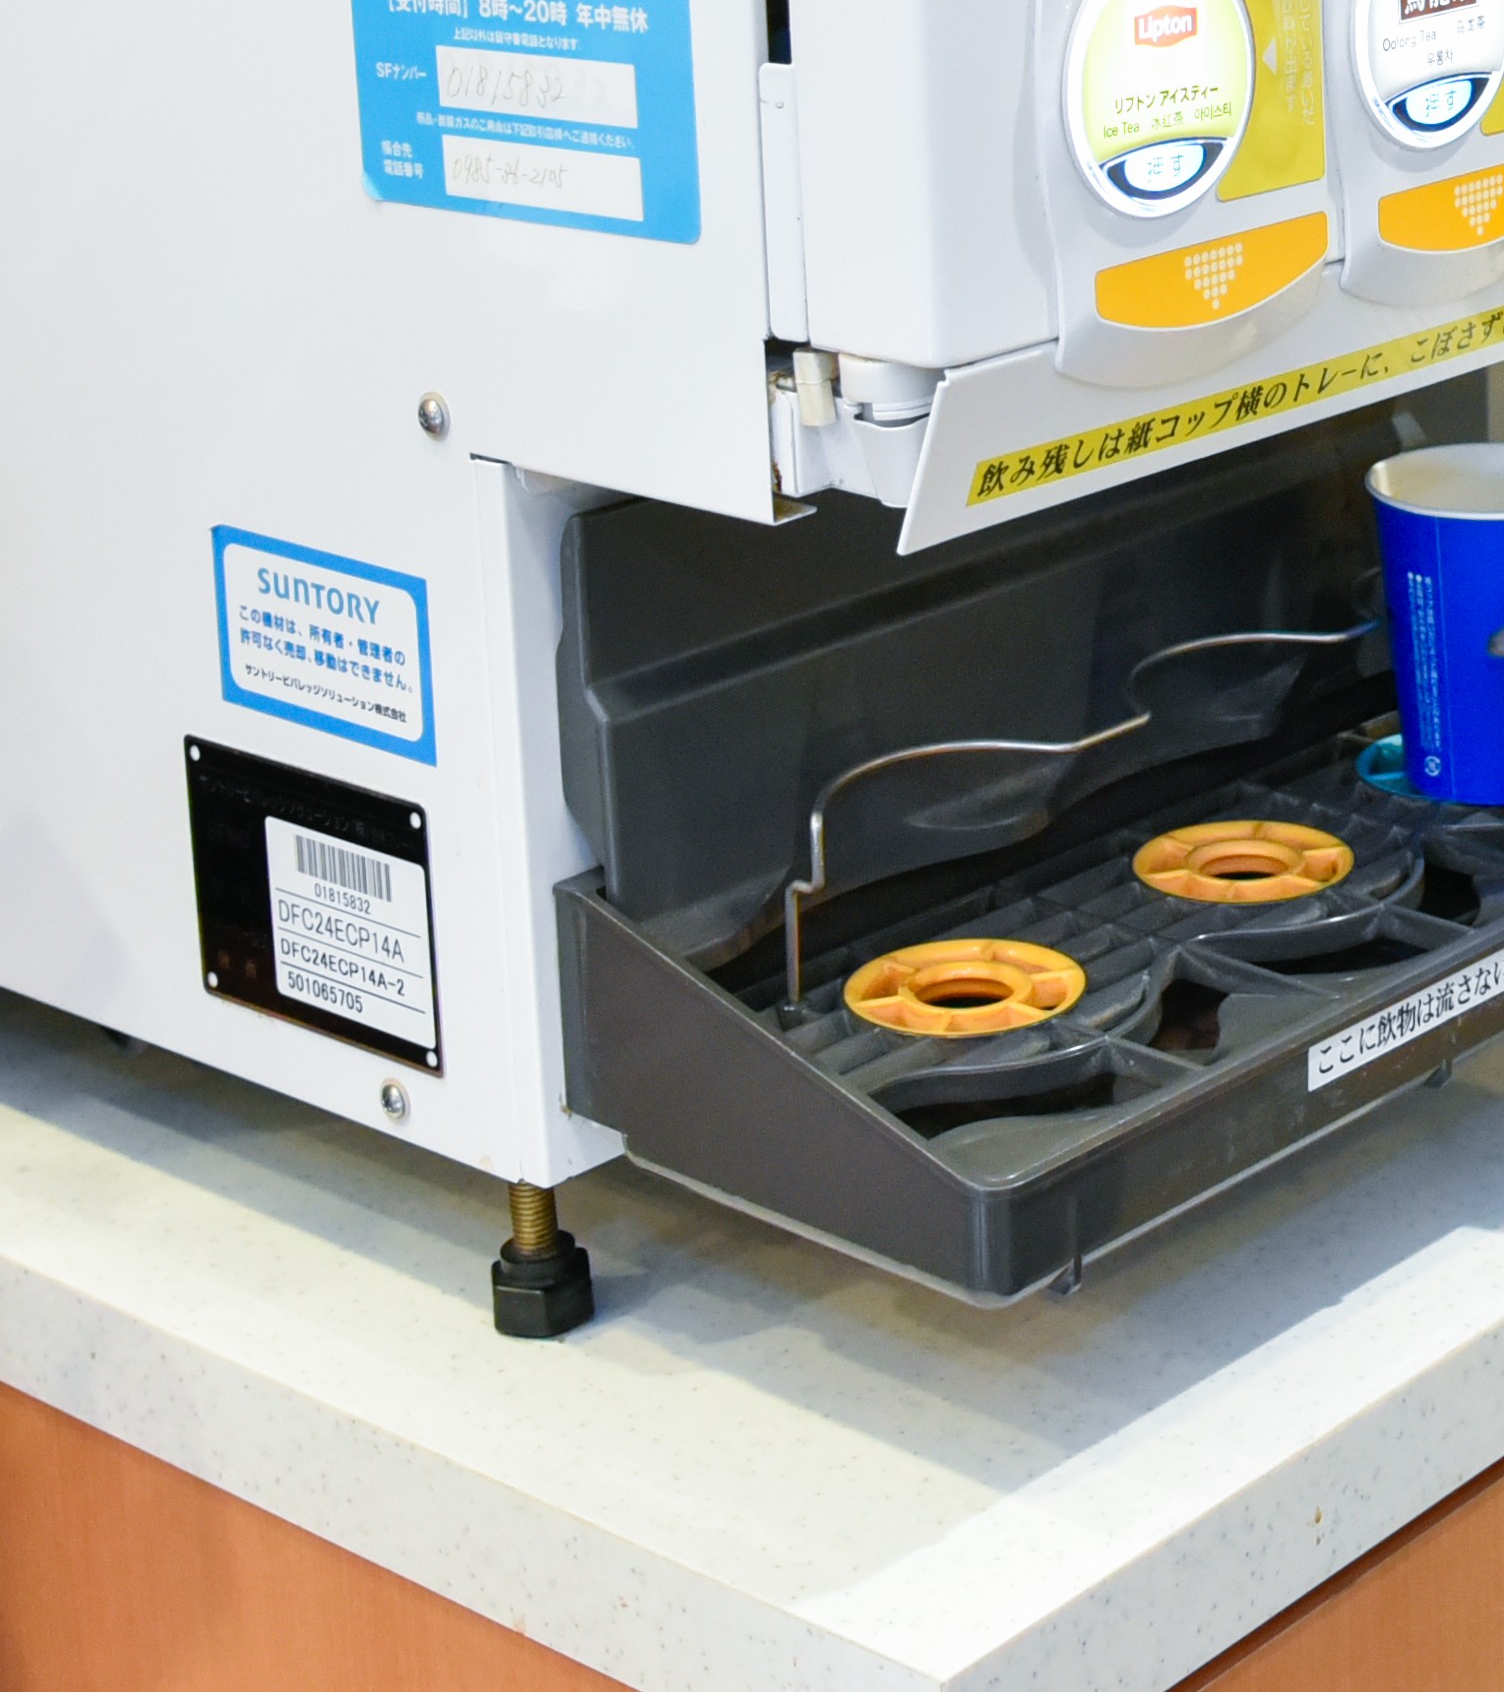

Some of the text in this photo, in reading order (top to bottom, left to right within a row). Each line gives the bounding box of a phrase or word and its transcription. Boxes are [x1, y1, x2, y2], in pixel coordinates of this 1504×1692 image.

[576, 2, 649, 33] 年中無休
[1138, 13, 1193, 43] Lipton
[1382, 36, 1417, 52] Oolong
[376, 62, 427, 80] SFナンバー
[1114, 85, 1220, 115] リフトン アイスティー
[1103, 121, 1140, 139] Ice Tea
[257, 567, 380, 624] SUNTORY
[314, 883, 371, 915] 01815832
[278, 898, 405, 962] DFC24ECP14A
[280, 938, 406, 997] DFC24ECP14A-2
[287, 972, 364, 1014] 501065705
